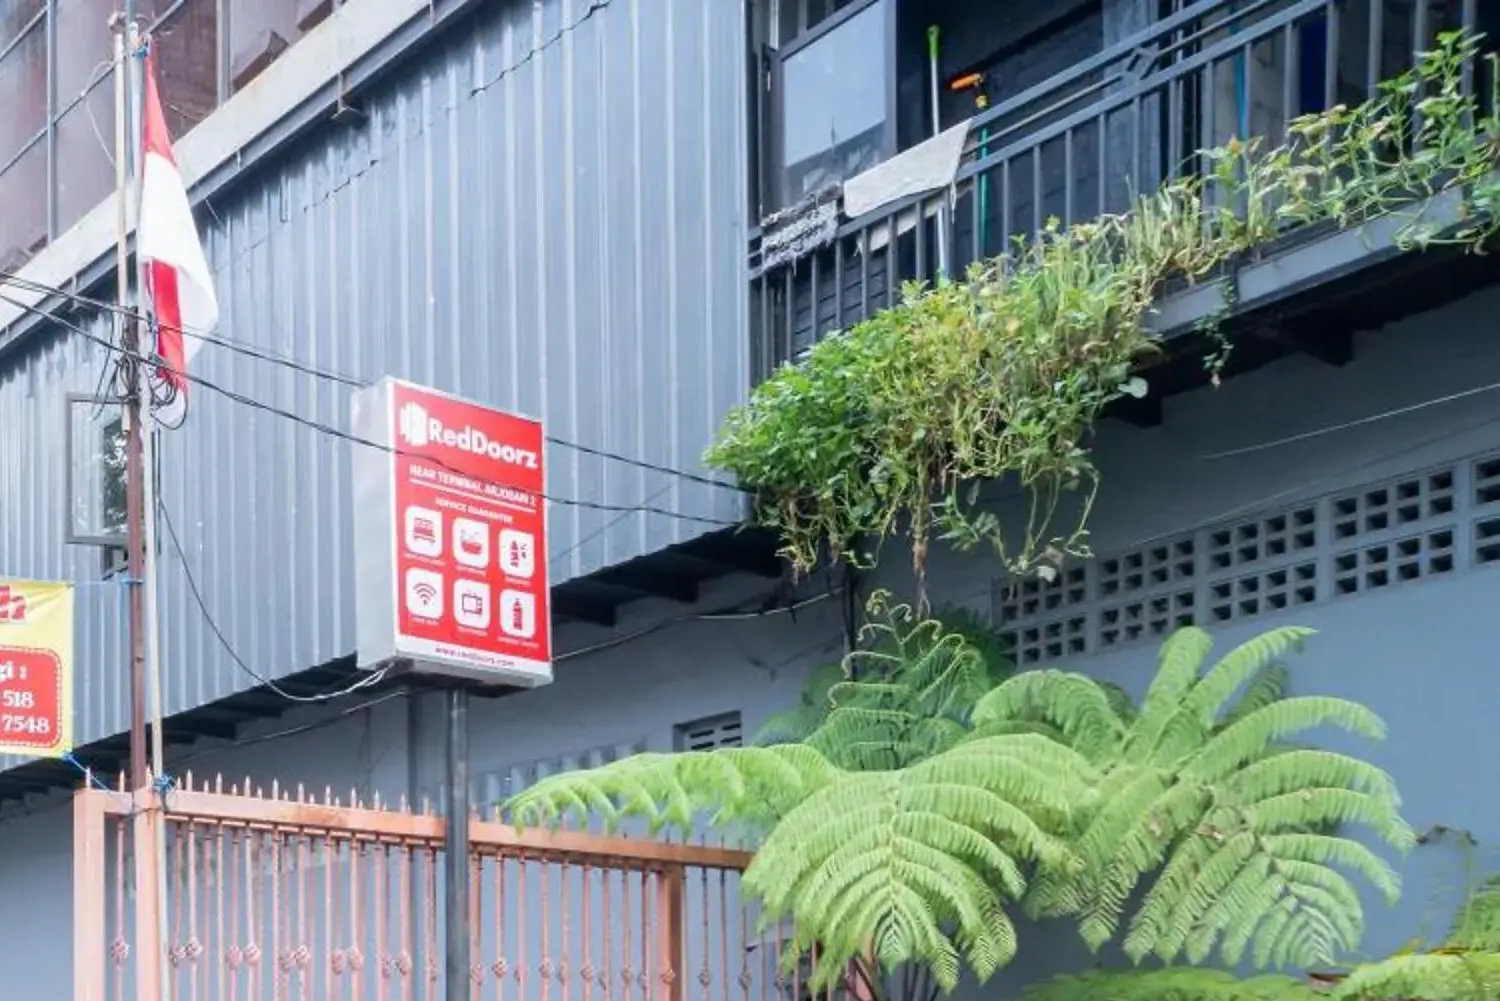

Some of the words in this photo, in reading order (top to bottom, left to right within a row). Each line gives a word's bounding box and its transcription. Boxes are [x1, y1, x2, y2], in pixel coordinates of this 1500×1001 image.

[428, 416, 539, 471] RedDoorz
[2, 690, 35, 709] 518
[1, 714, 51, 734] 7548
